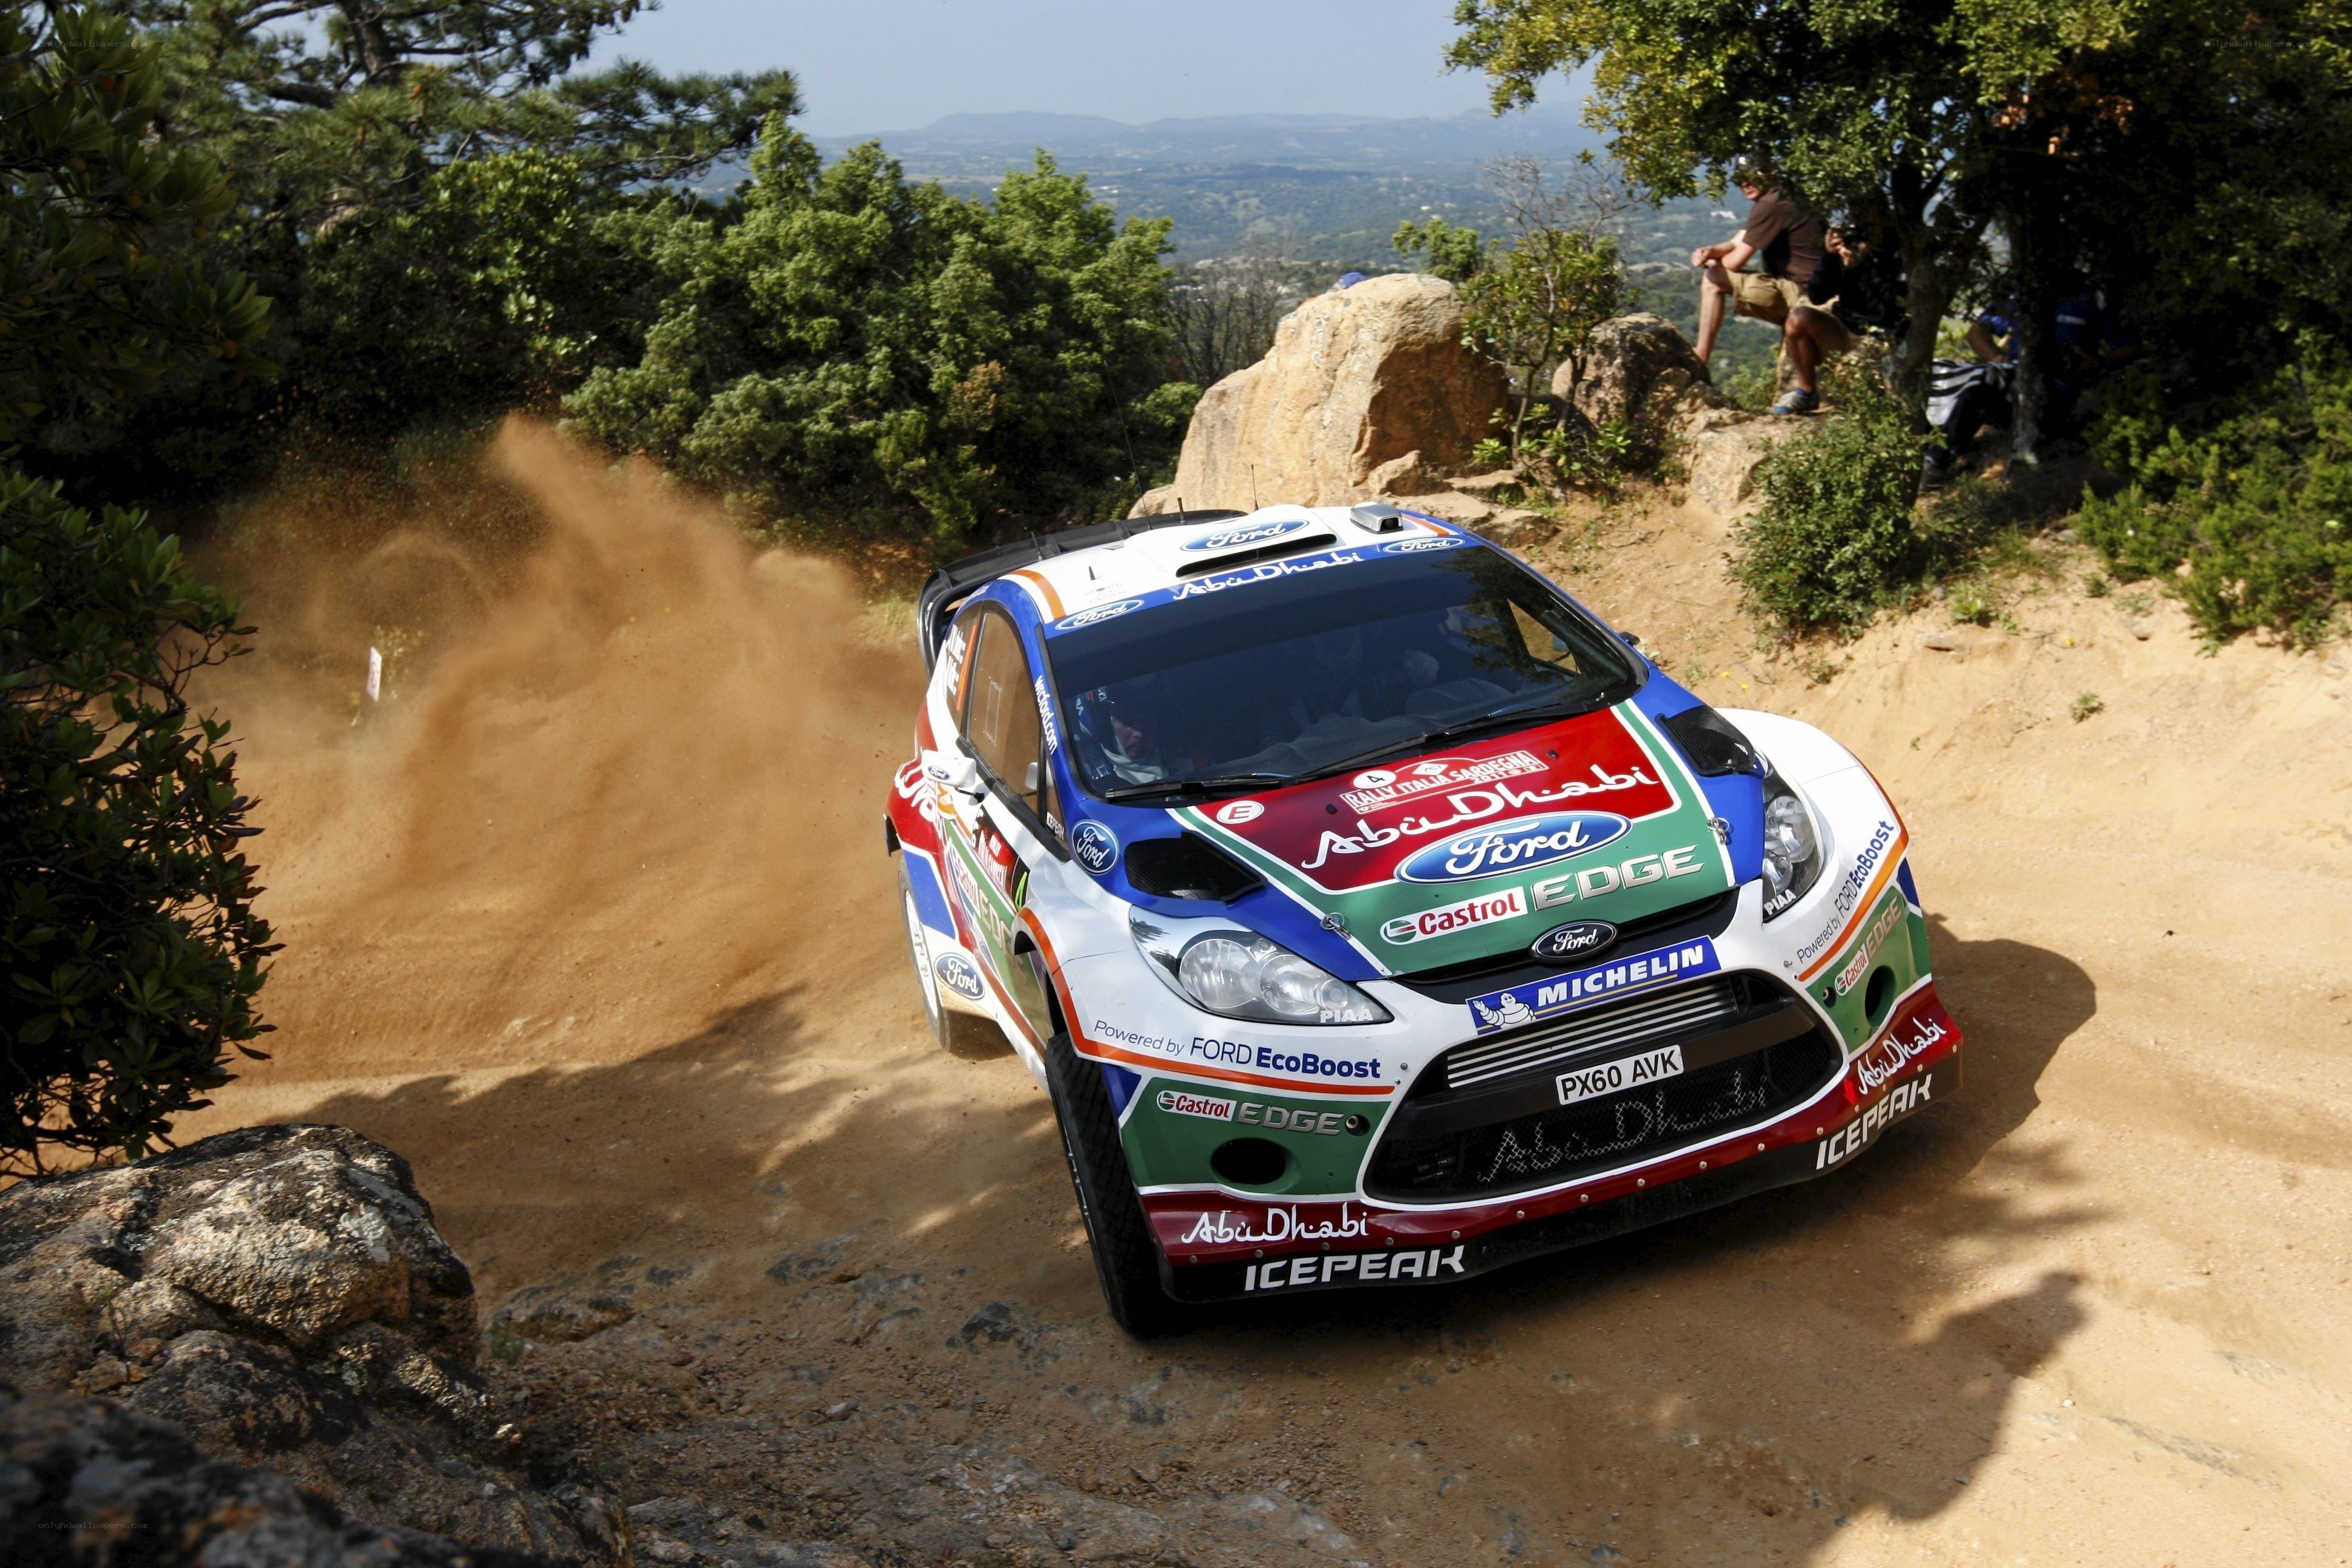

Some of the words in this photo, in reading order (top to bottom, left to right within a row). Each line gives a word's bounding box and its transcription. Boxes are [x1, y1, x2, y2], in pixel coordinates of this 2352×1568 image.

[1206, 522, 1287, 548] Ford
[1401, 538, 1451, 551] Ford
[1073, 604, 1127, 626] Ford
[1034, 675, 1058, 755] wrcford.com
[929, 765, 948, 779] Ford
[1345, 785, 1397, 808] RALLY
[1396, 774, 1452, 795] ITALIA
[1449, 753, 1538, 781] SARDEGNA
[1367, 774, 1385, 785] 4
[1470, 772, 1508, 784] 2011
[1228, 805, 1253, 820] E
[1076, 826, 1110, 868] Ford
[1445, 820, 1590, 875] Ford
[1849, 819, 1895, 889] EcoBoost
[1417, 894, 1520, 935] Castrol
[1531, 843, 1705, 912] EDGE
[1763, 889, 1797, 916] PIAA
[1834, 879, 1858, 918] FORD
[1552, 927, 1599, 954] Ford
[1831, 914, 1843, 930] by
[1844, 948, 1868, 987] Castrol
[1866, 896, 1902, 959] EDGE
[1796, 923, 1834, 964] Powered
[946, 959, 979, 995] Ford
[1537, 944, 1705, 1007] MICHELIN
[1320, 1008, 1374, 1024] PIAA
[1093, 1019, 1163, 1051] Powered
[1165, 1036, 1185, 1056] by
[1189, 1036, 1252, 1065] FORD
[1255, 1046, 1381, 1079] EcoBoost
[1561, 1065, 1622, 1100] PX60
[1631, 1050, 1680, 1083] AVK
[1175, 1094, 1231, 1119] Castrol
[1236, 1102, 1345, 1137] EDGE
[1816, 1073, 1932, 1171] ICEPEAK
[1244, 1244, 1466, 1292] ICEPEAK
